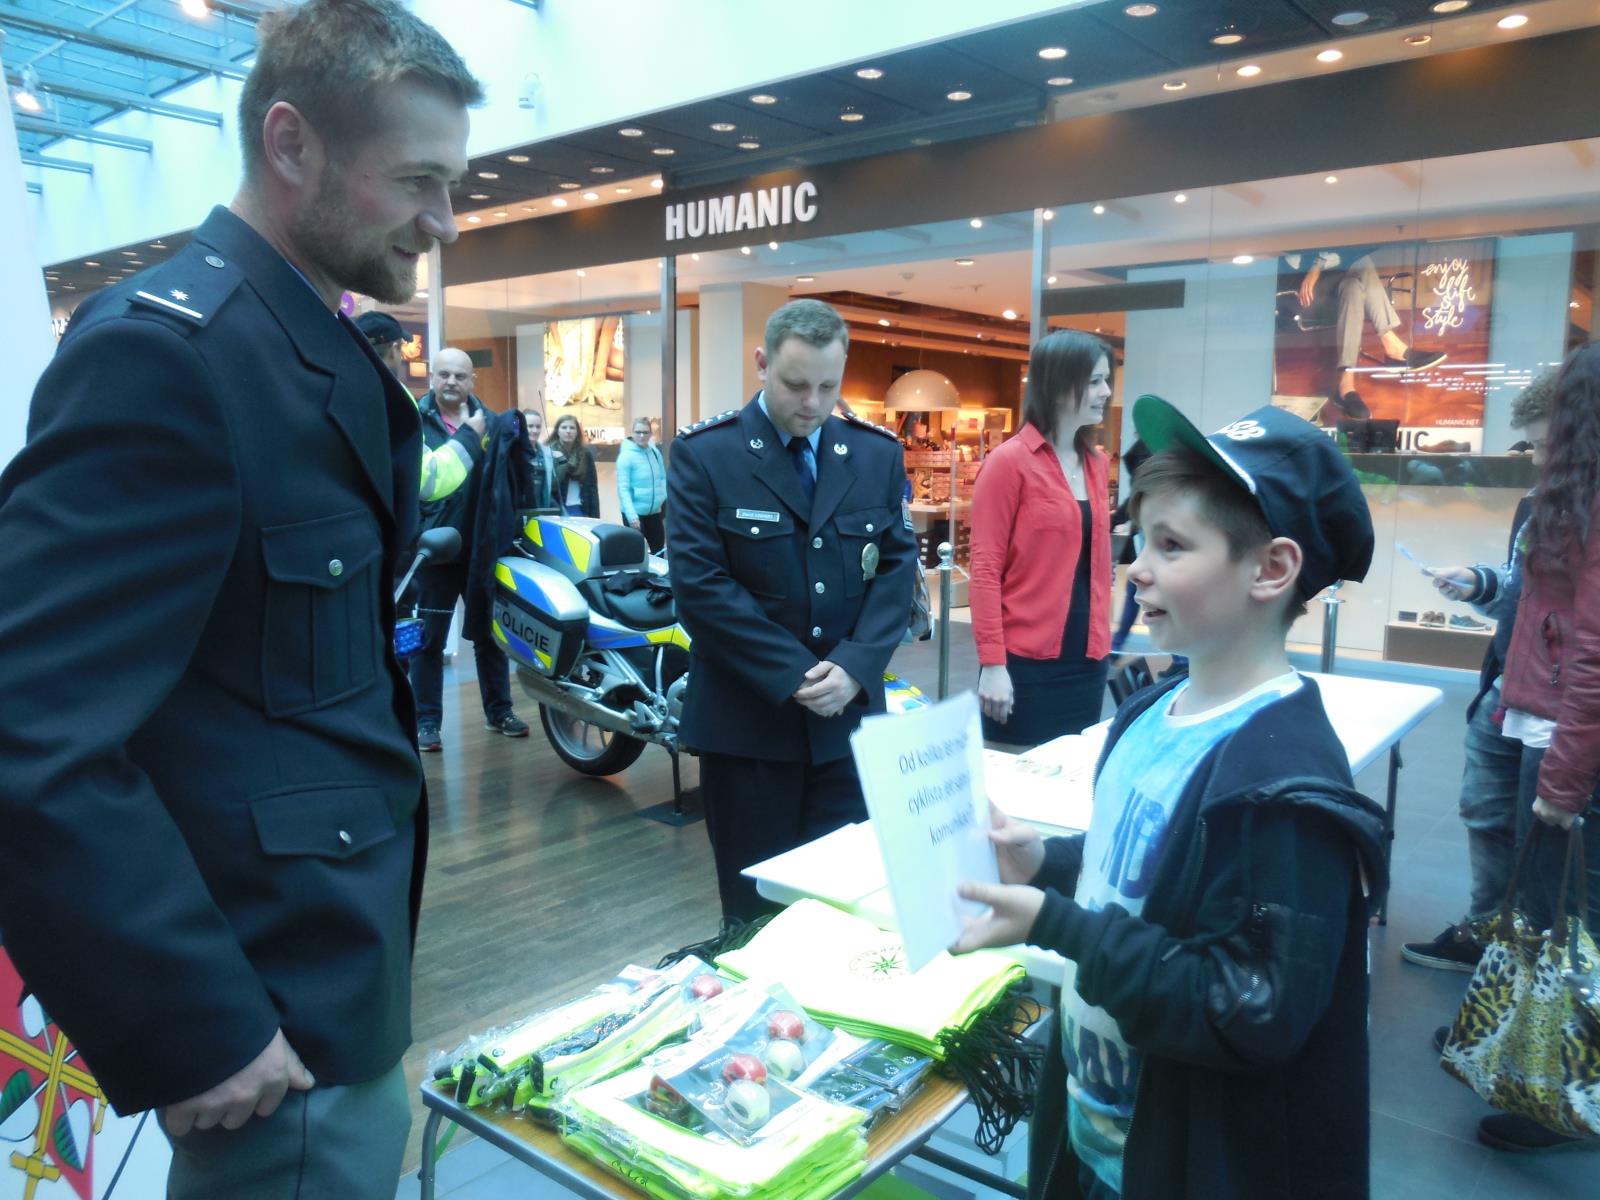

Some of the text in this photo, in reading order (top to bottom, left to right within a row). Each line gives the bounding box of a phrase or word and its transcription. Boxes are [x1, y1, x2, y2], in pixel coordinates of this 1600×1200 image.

[665, 181, 818, 241] HUMANIC
[1421, 257, 1469, 289] enjoy
[899, 750, 916, 775] Od
